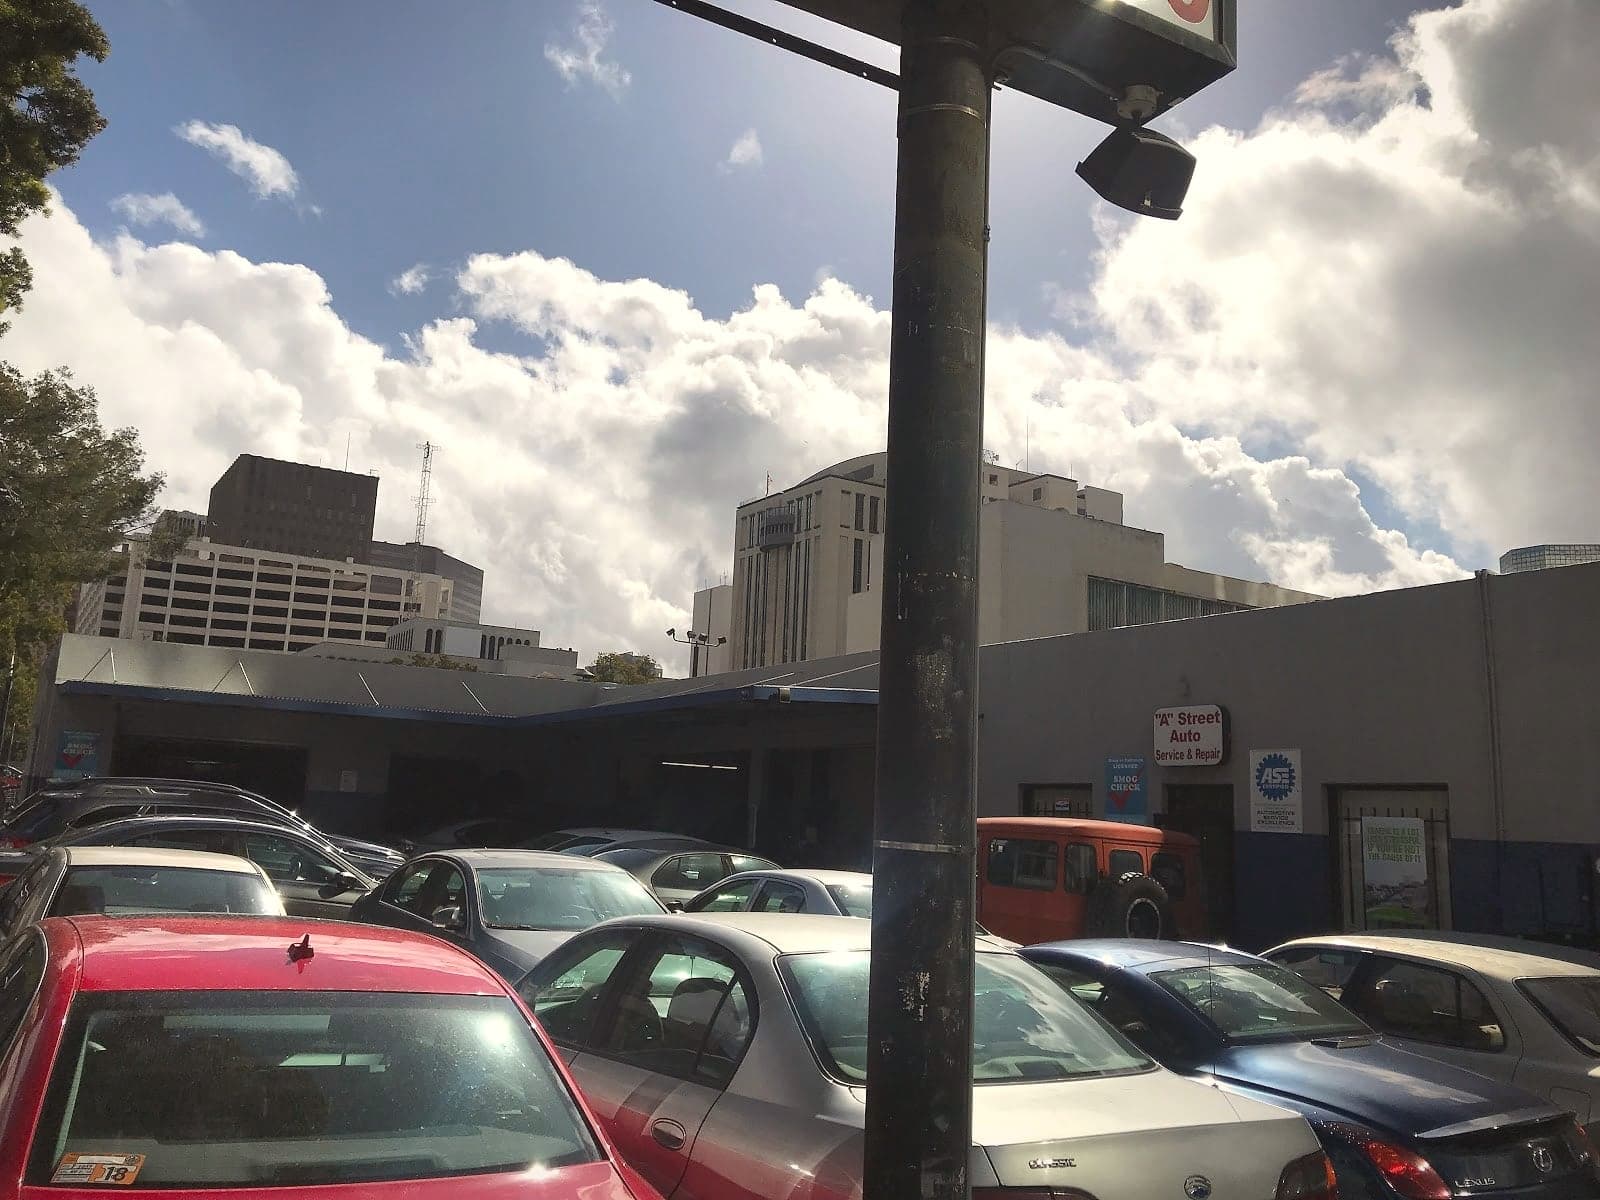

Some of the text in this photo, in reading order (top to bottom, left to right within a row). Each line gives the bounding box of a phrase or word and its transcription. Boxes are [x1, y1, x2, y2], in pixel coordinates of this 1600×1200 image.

[1155, 710, 1221, 727] "A" Street
[1169, 729, 1201, 743] Auto
[1155, 749, 1185, 761] Service
[1187, 748, 1193, 760] &
[1195, 747, 1221, 762] Repair
[1113, 775, 1138, 783] SMOG
[1260, 767, 1290, 784] ASE
[1110, 783, 1141, 792] CHECK
[104, 1166, 128, 1181] 18
[1454, 1177, 1496, 1188] LEXUS
